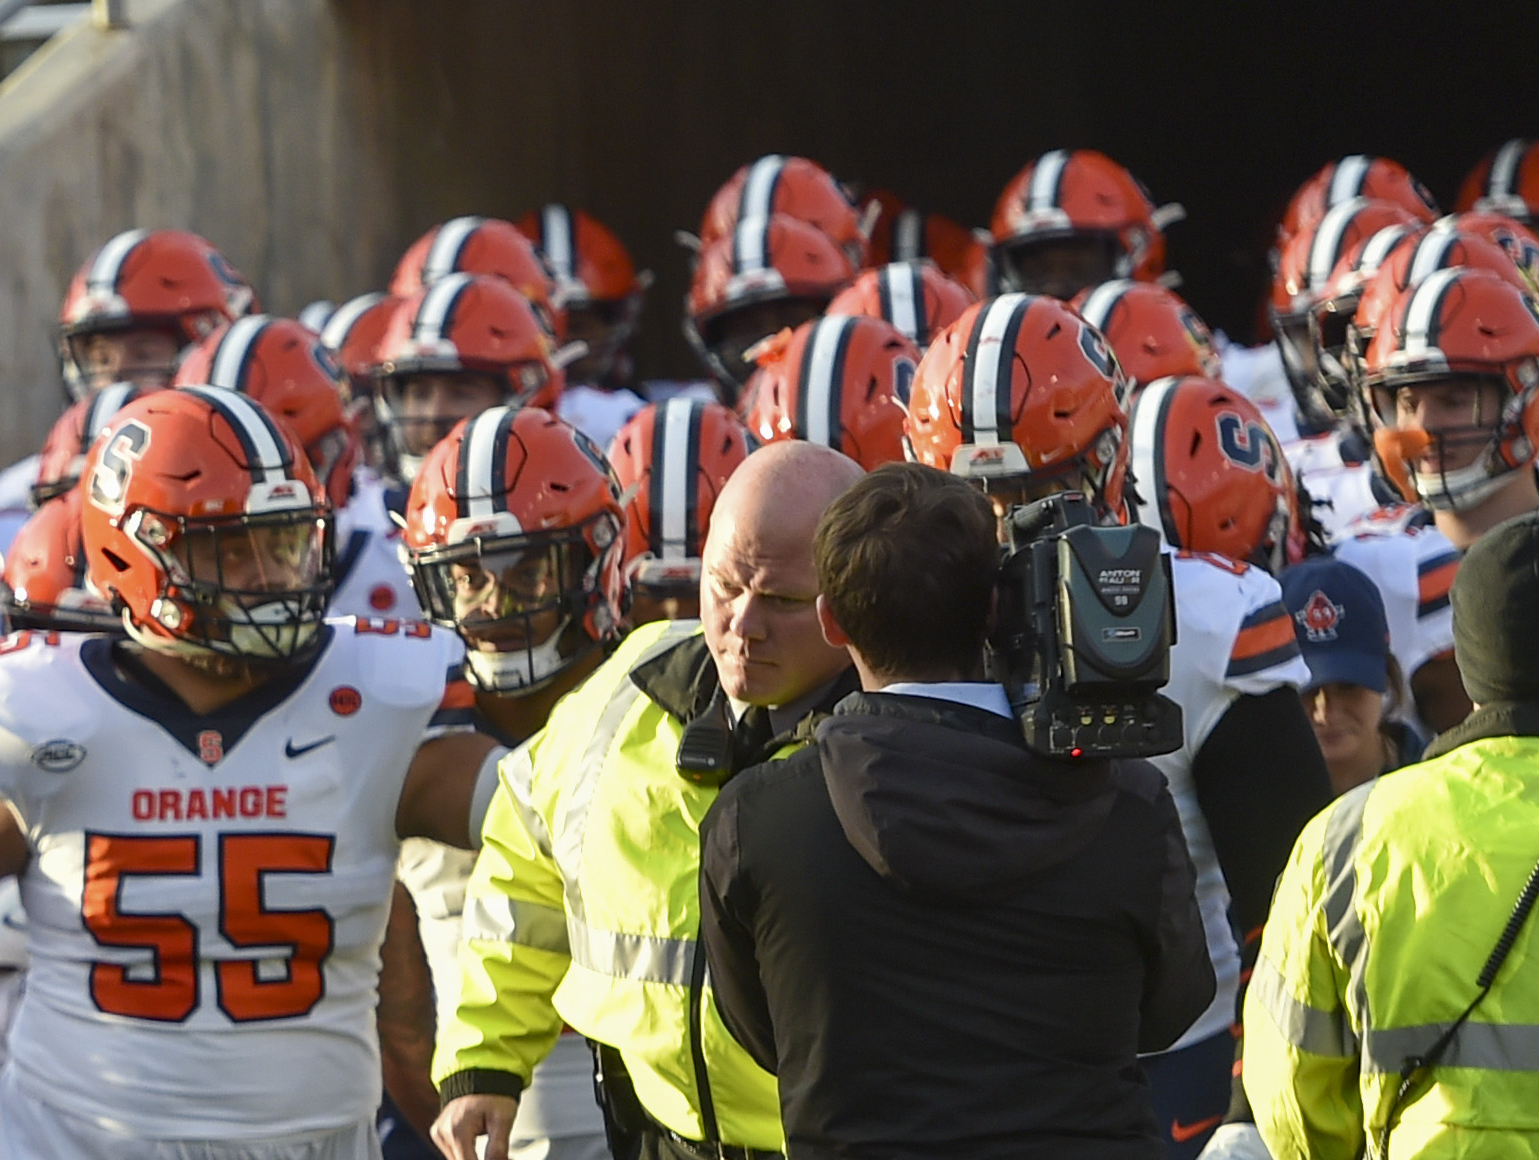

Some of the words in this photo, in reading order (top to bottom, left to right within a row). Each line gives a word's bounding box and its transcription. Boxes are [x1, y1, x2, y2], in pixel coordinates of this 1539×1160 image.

[90, 418, 151, 518] S
[1099, 569, 1141, 578] ANTON
[199, 730, 223, 765] S
[132, 786, 289, 823] ORANGE
[81, 829, 337, 1024] 55
